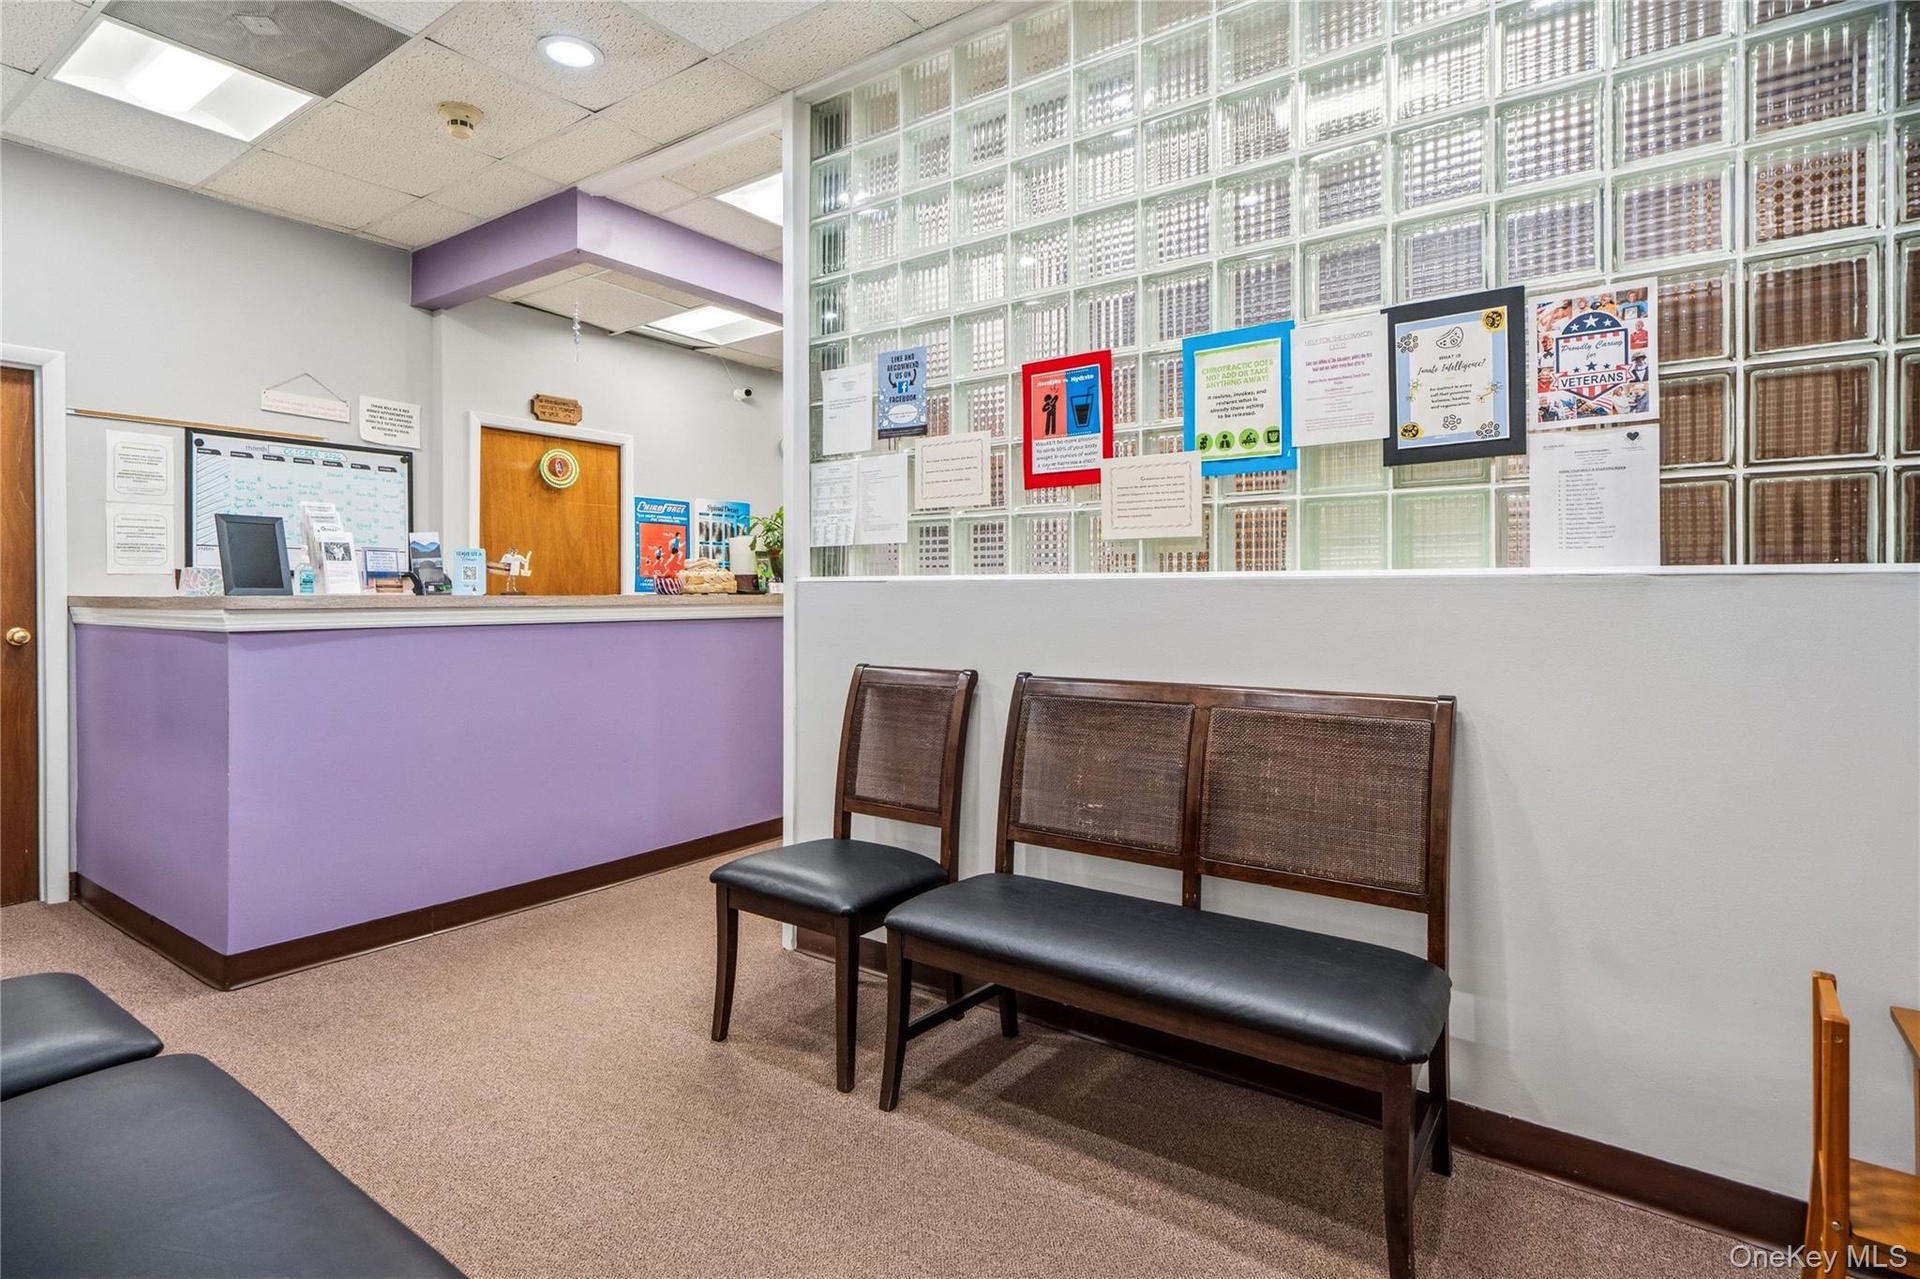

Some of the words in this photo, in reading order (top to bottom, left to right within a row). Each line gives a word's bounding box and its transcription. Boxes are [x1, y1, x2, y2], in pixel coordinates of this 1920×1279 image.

[1343, 331, 1373, 340] COMMON
[1561, 342, 1592, 353] Proudly
[1595, 340, 1623, 350] Caring
[904, 353, 915, 361] AND
[1586, 352, 1597, 360] for
[887, 361, 919, 372] RECOMMEND
[1202, 361, 1253, 375] CHIROPRACTIC
[1254, 359, 1274, 367] DOES
[894, 372, 903, 380] US
[1205, 374, 1220, 382] NOT
[1221, 371, 1236, 379] ADD
[1251, 367, 1269, 375] TAKE
[1206, 379, 1242, 389] ANYTHING
[1244, 375, 1269, 384] AWAY!
[1561, 372, 1624, 388] VETERANS
[889, 394, 917, 403] FACEBOOK
[707, 503, 724, 513] Spinal
